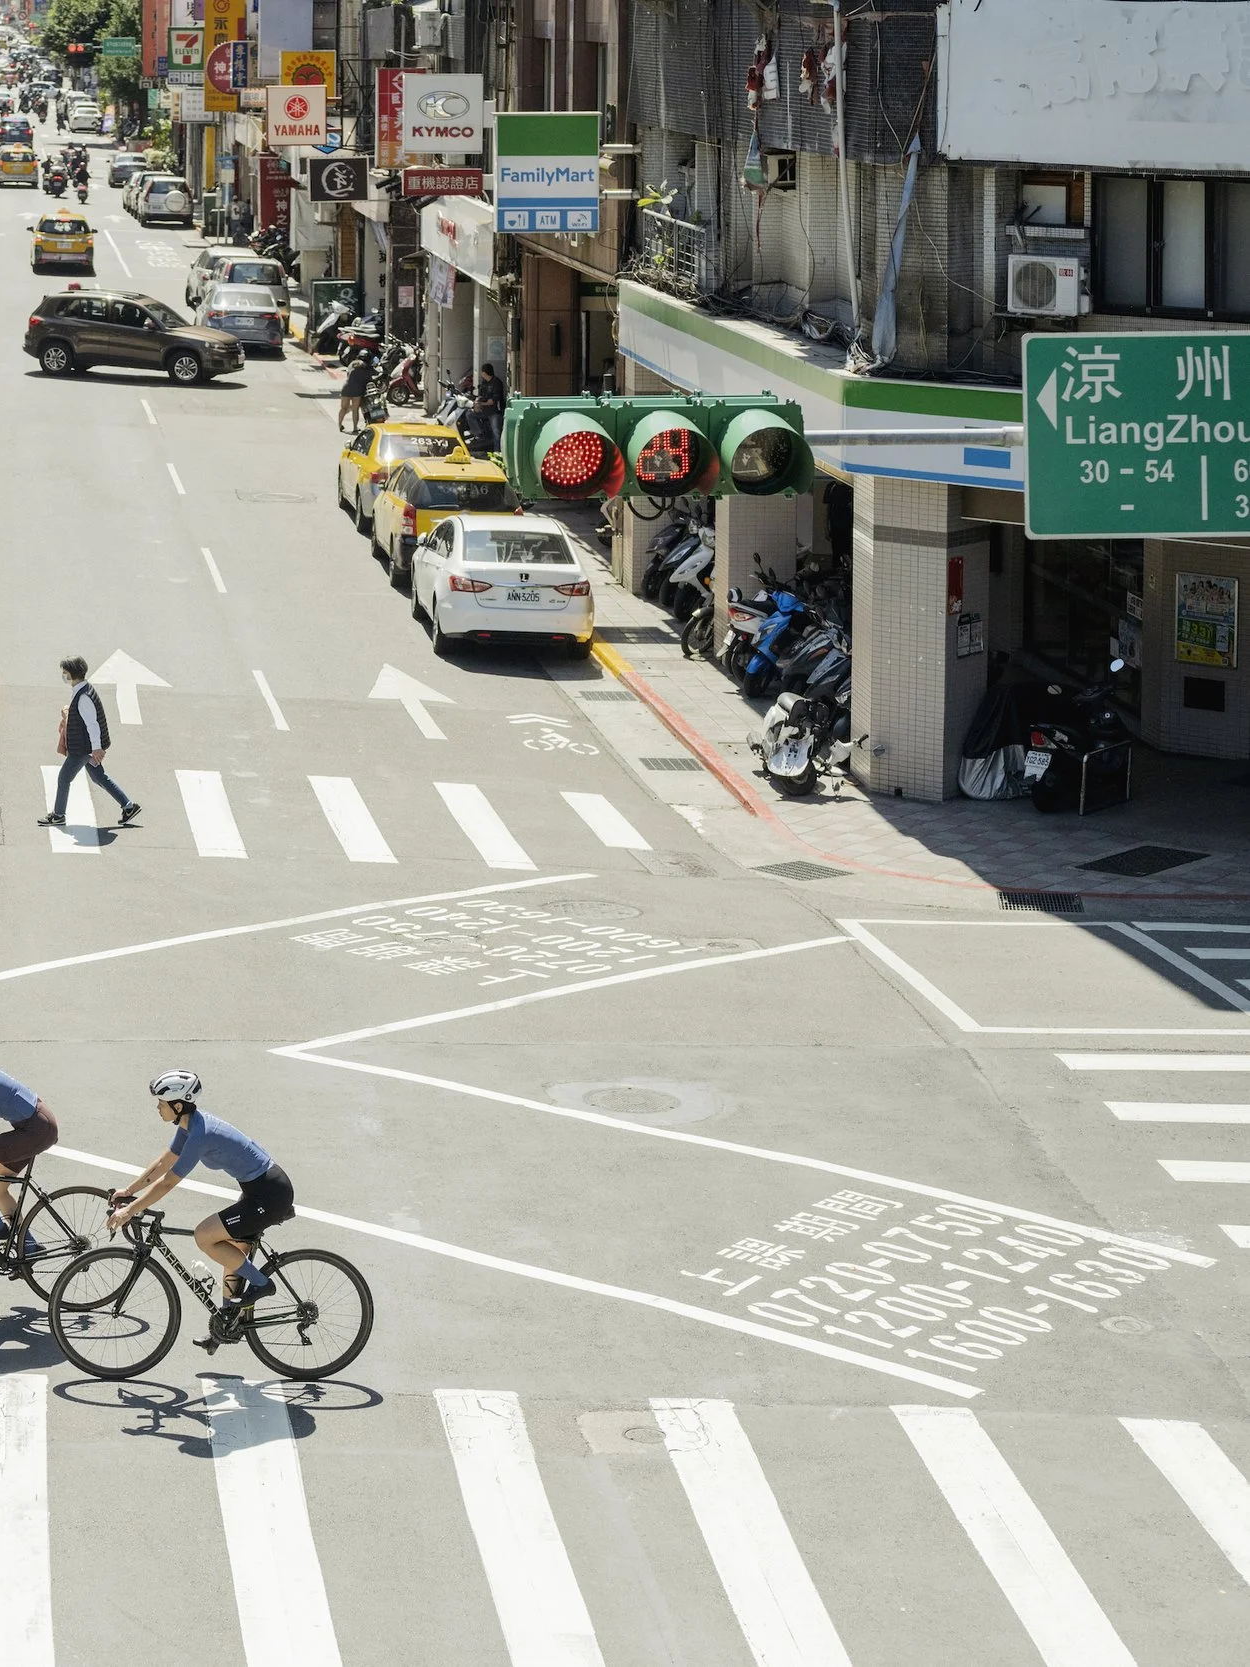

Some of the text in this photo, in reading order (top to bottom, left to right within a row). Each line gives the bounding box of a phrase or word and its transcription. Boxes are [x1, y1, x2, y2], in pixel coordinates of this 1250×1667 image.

[274, 125, 320, 136] YAMAHA
[412, 126, 474, 138] KYMCO
[407, 176, 479, 191] 重機認證店
[500, 167, 595, 186] FamilyMart
[539, 215, 557, 226] ATM
[1061, 345, 1231, 403] 涼州
[411, 437, 449, 448] 263-YJ
[1079, 459, 1110, 484] 30
[1144, 458, 1175, 483] 54
[404, 906, 658, 963] 1200-1240
[457, 899, 704, 955] 1600-1630
[290, 928, 551, 986] 上課期間
[680, 1189, 904, 1297] 上課期間
[747, 1203, 1005, 1328] 0720-0750
[822, 1223, 1086, 1349] 1200-1240
[904, 1242, 1172, 1372] 1600-1630
